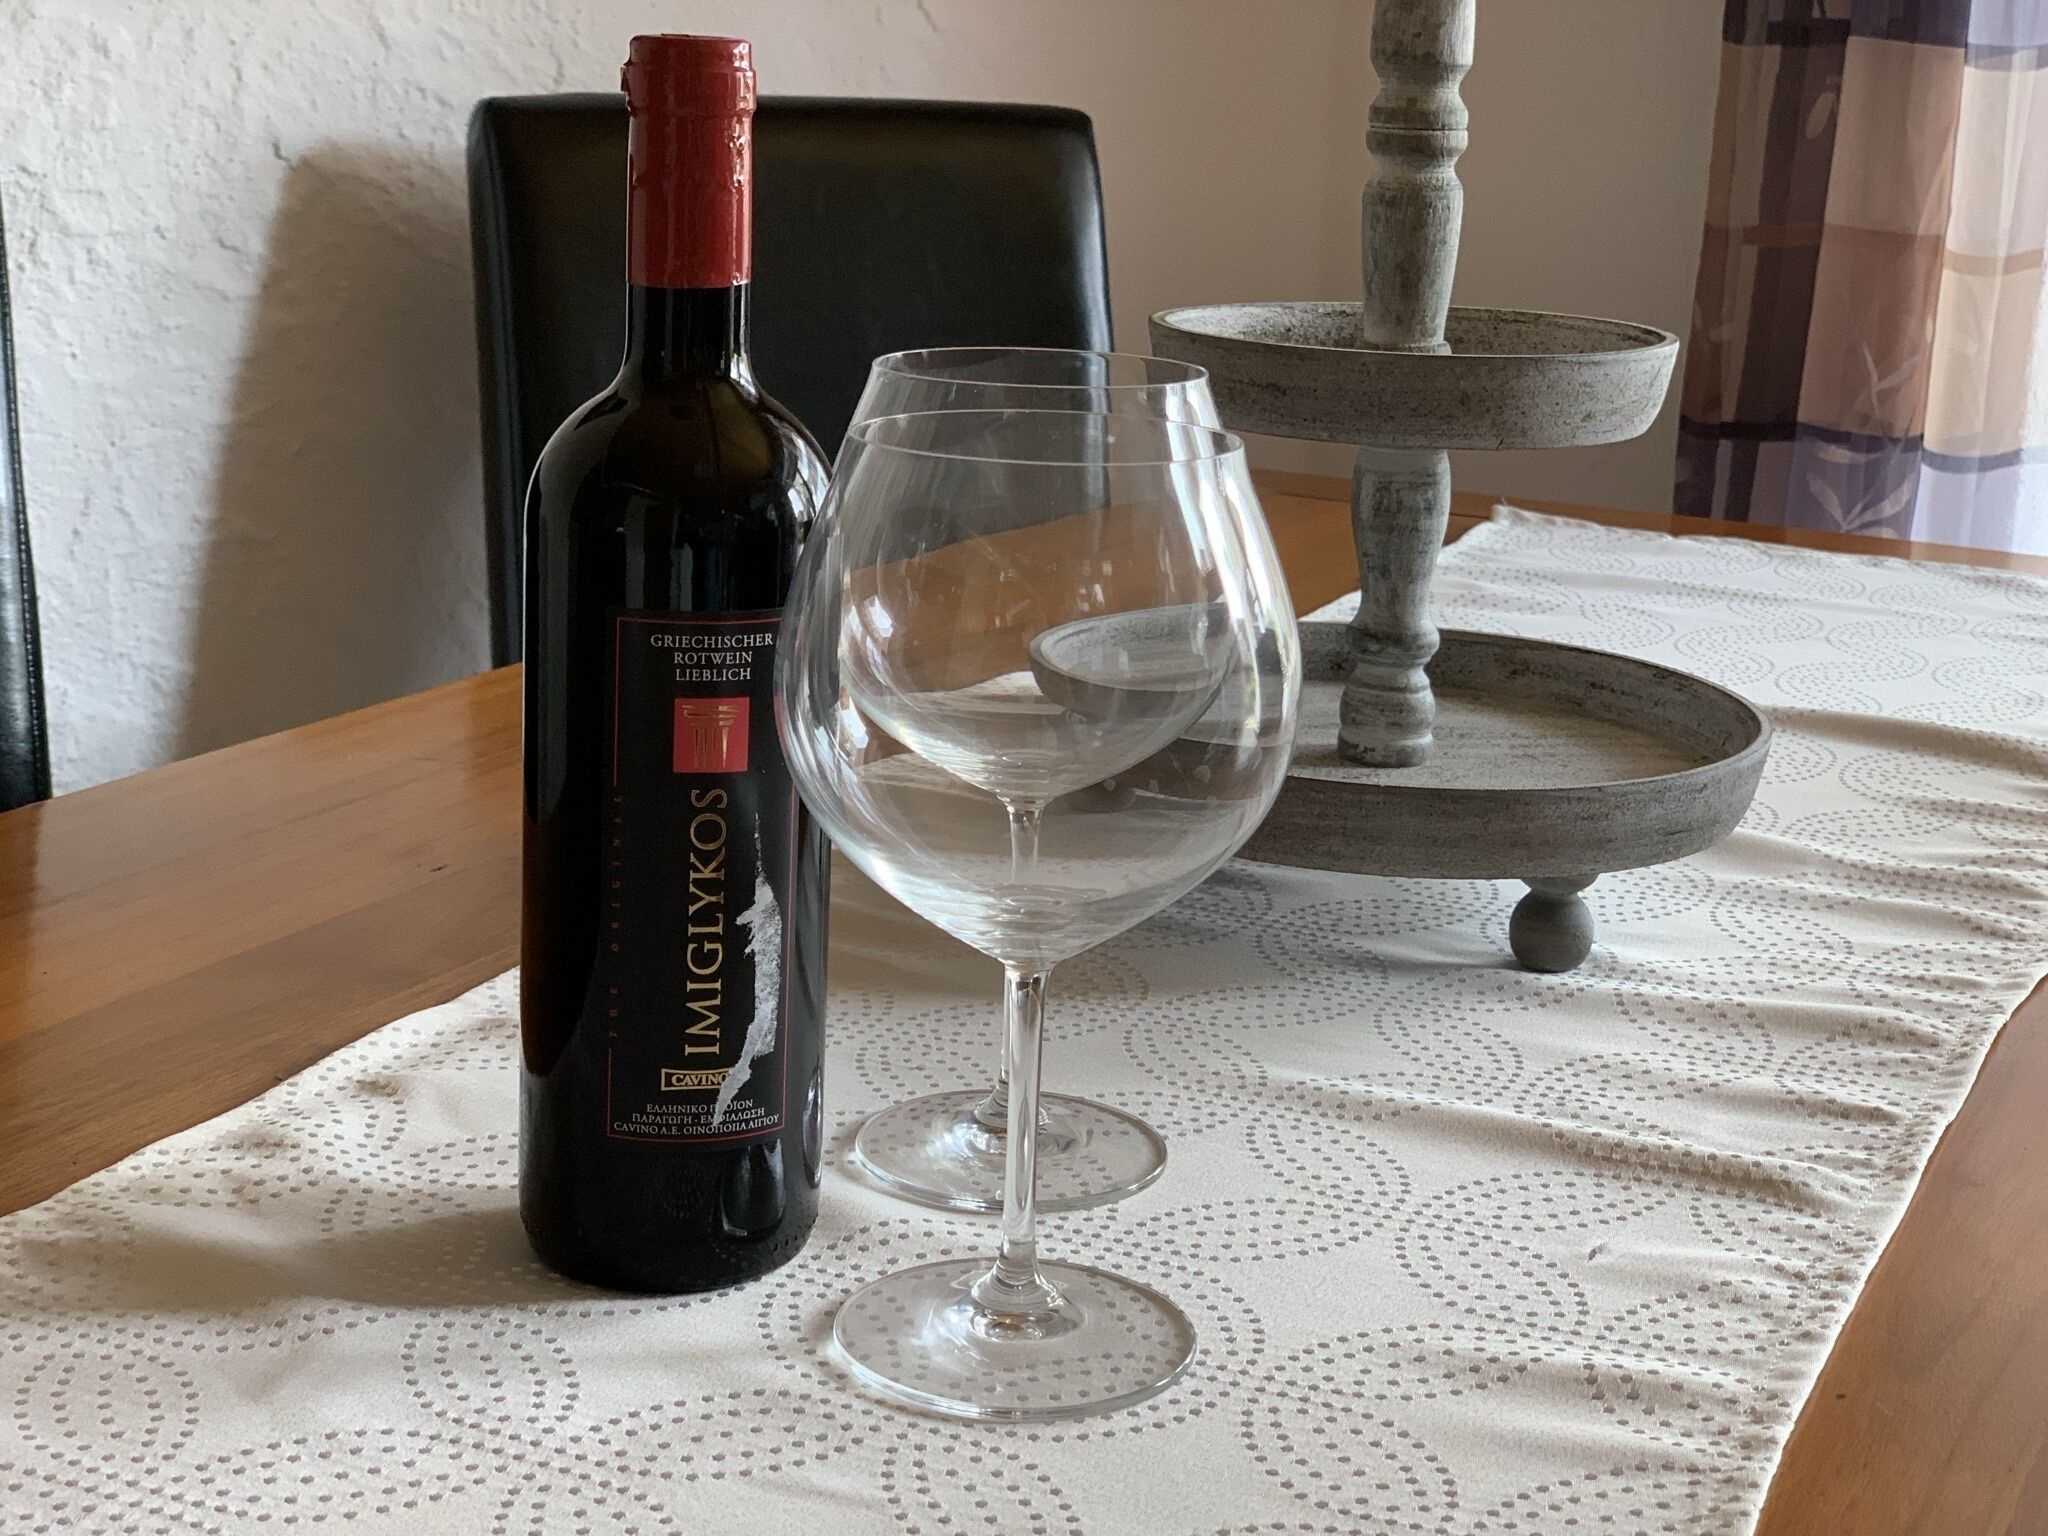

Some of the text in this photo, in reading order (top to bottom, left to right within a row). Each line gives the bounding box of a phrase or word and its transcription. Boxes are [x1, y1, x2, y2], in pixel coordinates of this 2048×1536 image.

[650, 633, 774, 648] GRIECHISCHER
[673, 651, 753, 665] ROTWEIN
[675, 668, 751, 681] LIEBLICH
[684, 788, 728, 1056] IMIGLYKOS
[608, 987, 619, 1038] THE
